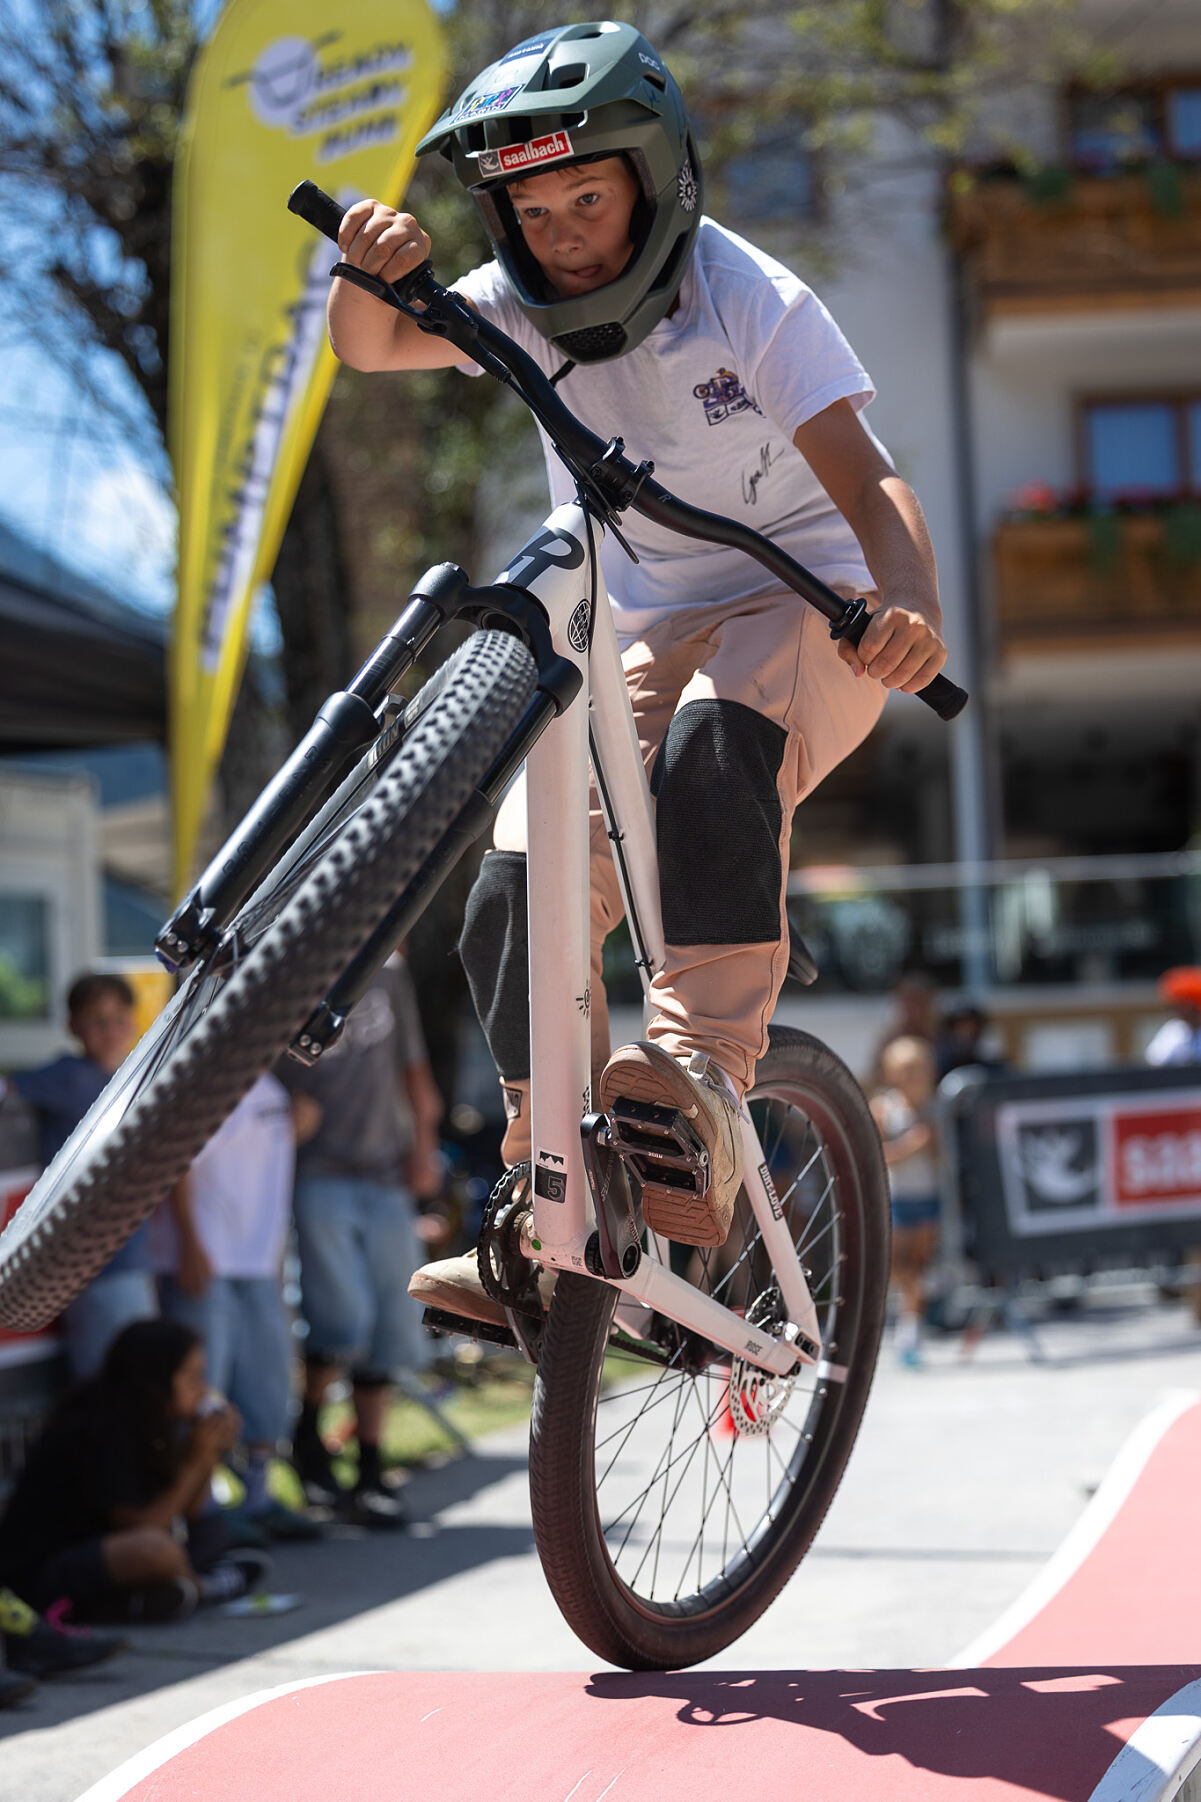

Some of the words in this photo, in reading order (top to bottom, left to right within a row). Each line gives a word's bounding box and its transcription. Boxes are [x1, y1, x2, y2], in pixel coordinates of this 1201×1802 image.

[638, 52, 660, 71] POC
[502, 133, 565, 167] saalbach
[547, 1175, 565, 1201] 5
